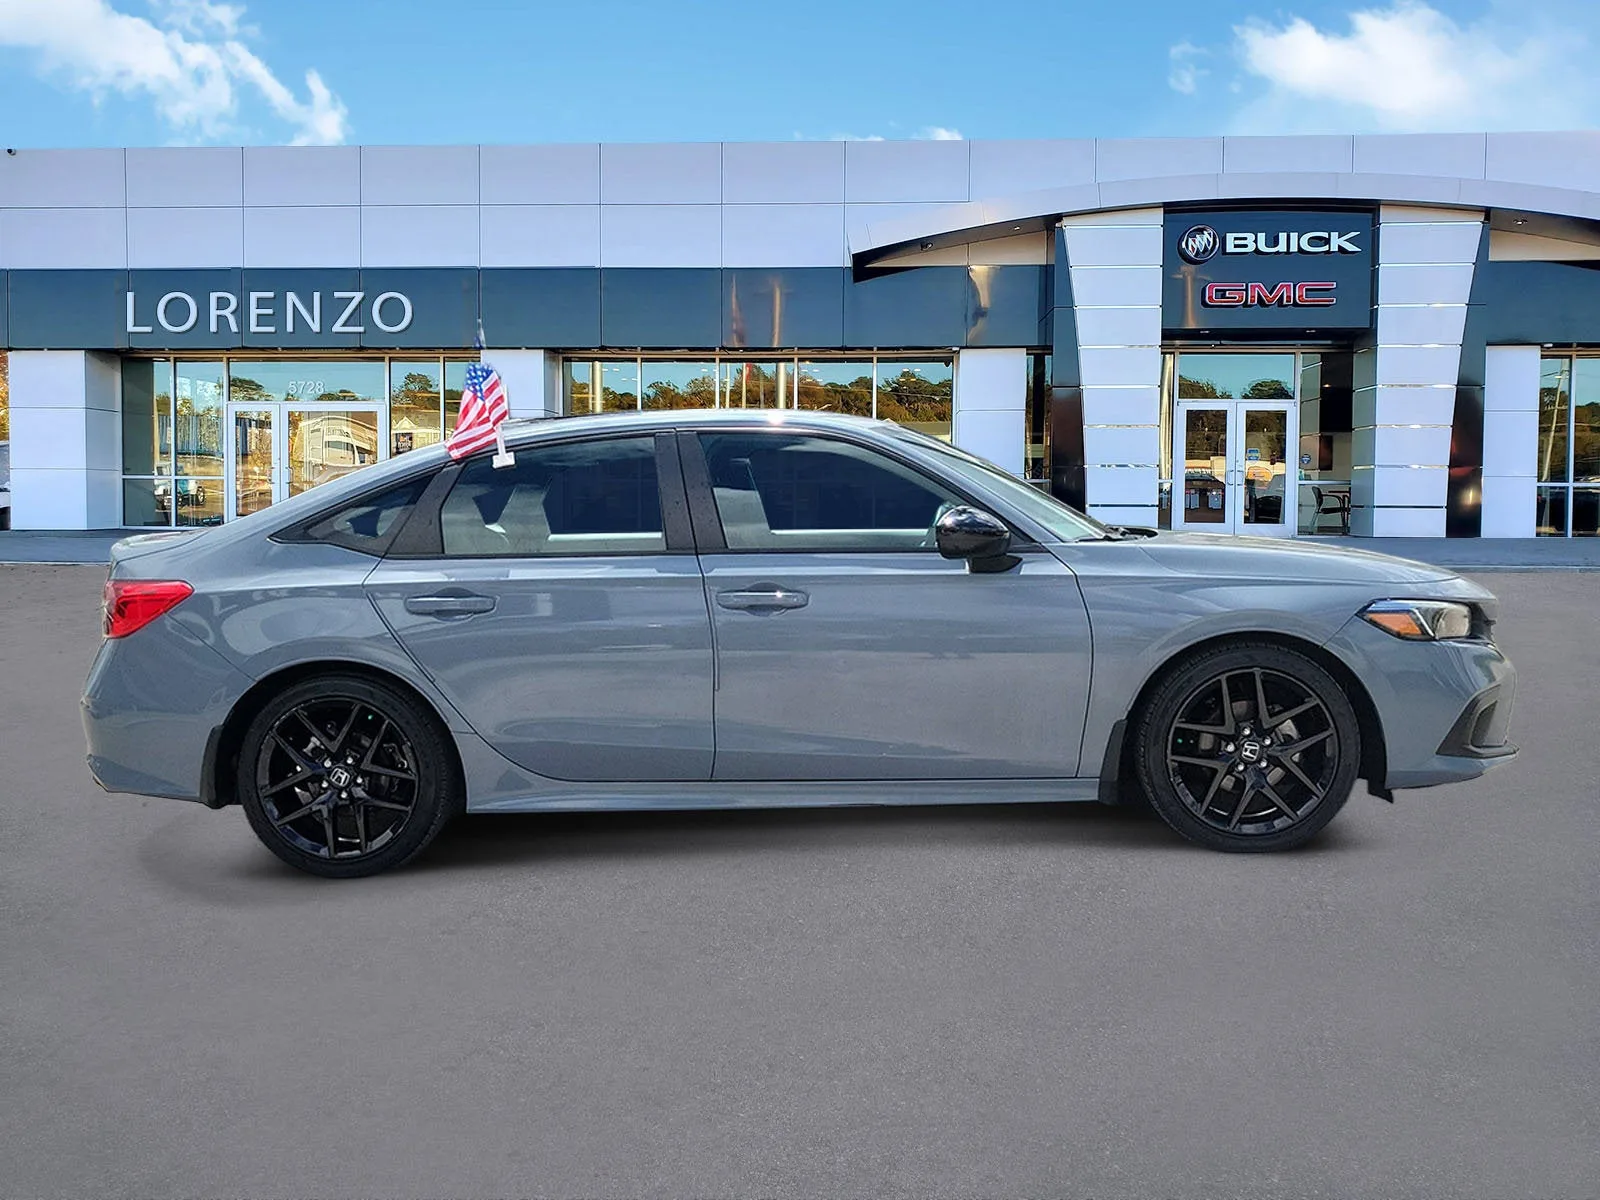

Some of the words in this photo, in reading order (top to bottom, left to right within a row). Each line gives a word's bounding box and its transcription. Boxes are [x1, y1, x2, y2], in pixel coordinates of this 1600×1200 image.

[1225, 231, 1362, 253] BUICK
[1205, 281, 1337, 305] GMC
[126, 291, 414, 334] LORENZO
[288, 380, 325, 394] 5728
